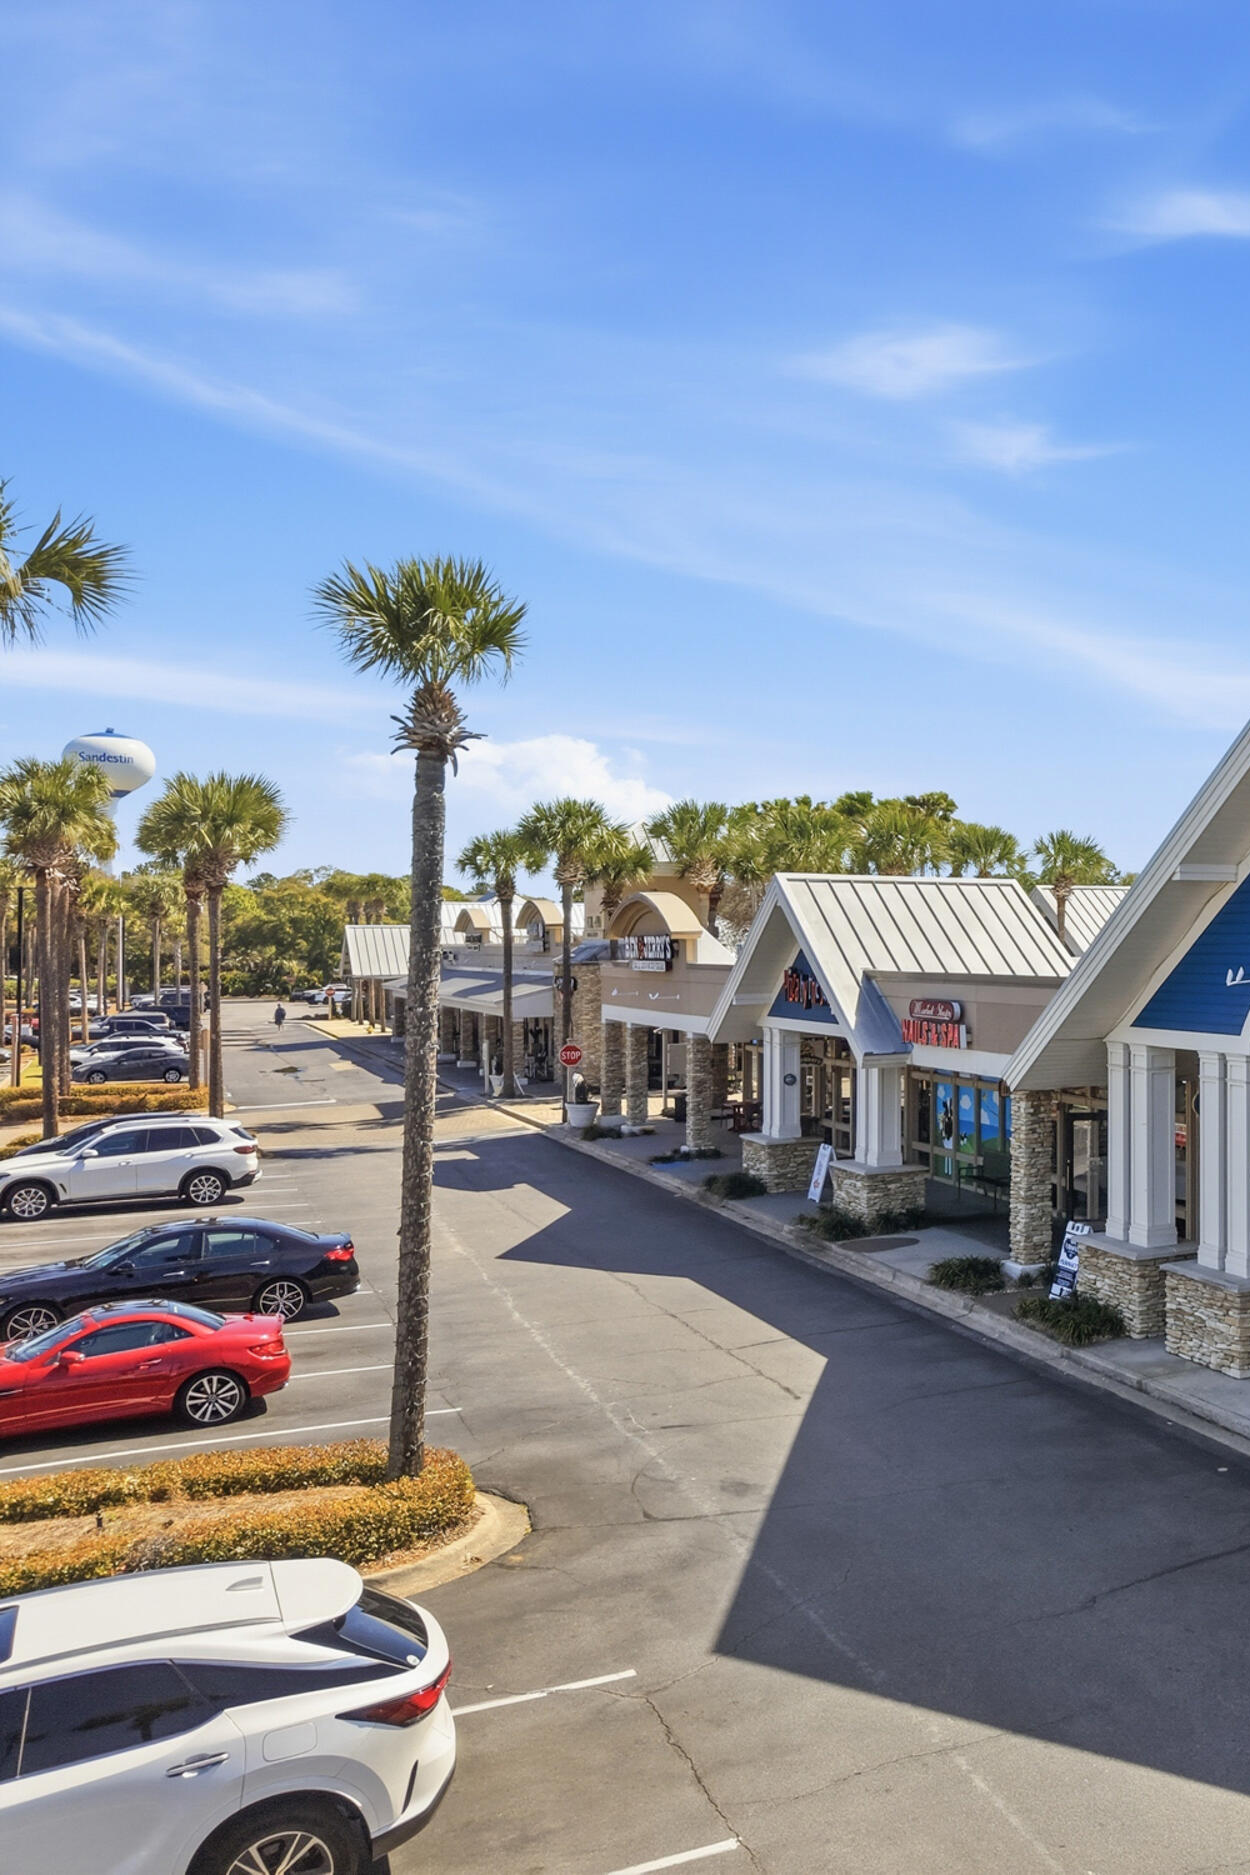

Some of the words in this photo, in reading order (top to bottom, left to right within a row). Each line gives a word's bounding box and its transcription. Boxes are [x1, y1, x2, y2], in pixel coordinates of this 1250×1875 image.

[79, 752, 134, 764] Sandestin
[902, 1019, 928, 1045] NAILS
[941, 1023, 959, 1048] SPA
[561, 1051, 580, 1060] STOP
